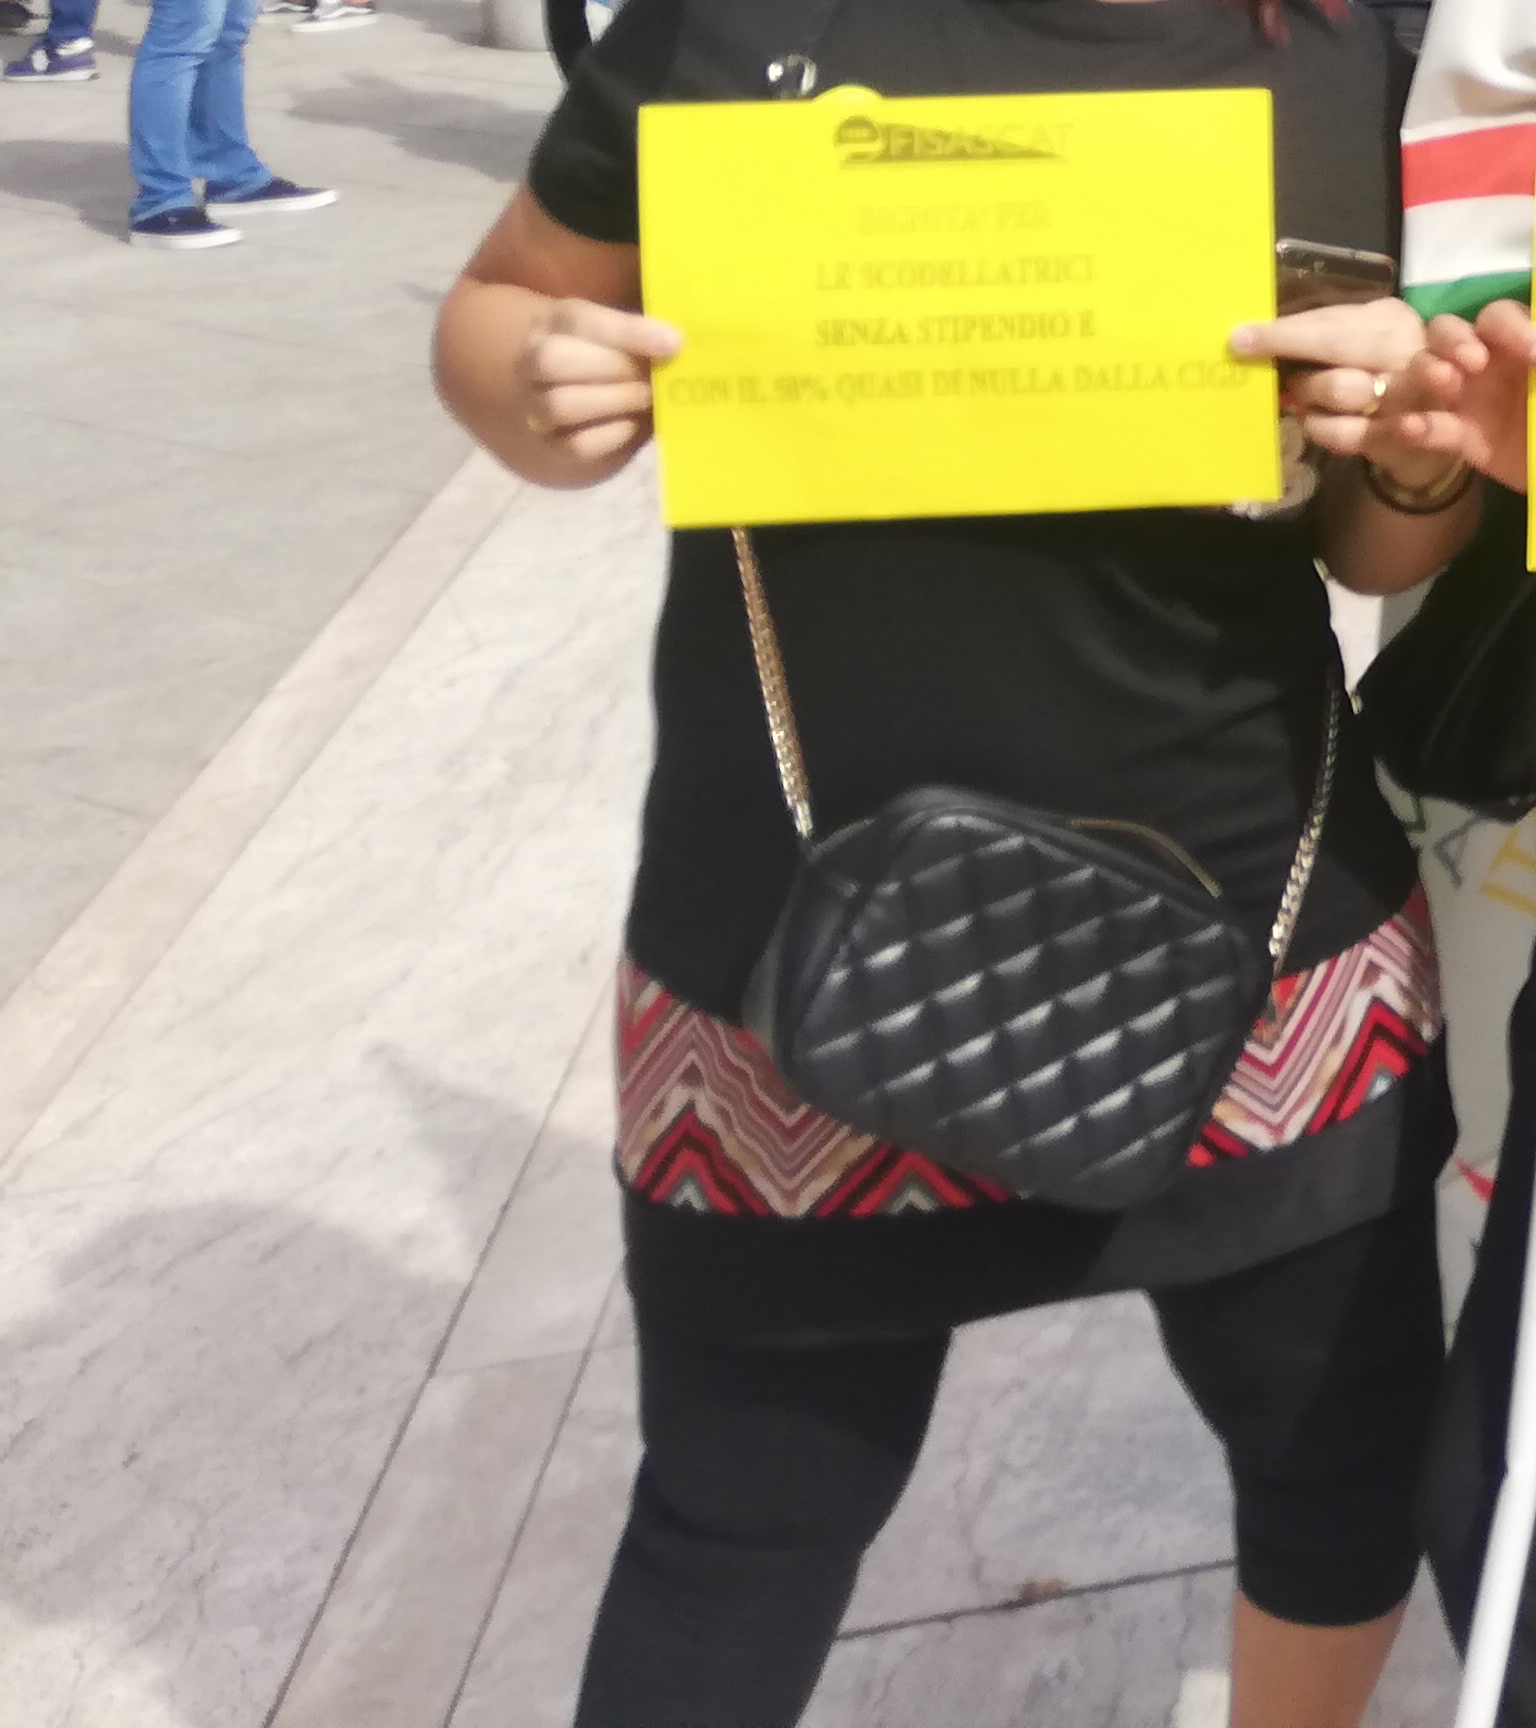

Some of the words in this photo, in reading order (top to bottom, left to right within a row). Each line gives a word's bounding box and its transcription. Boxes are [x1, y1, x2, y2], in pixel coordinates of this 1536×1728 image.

[814, 317, 909, 350] SENZA
[917, 312, 1072, 345] STIPENDIO
[1079, 309, 1098, 339] E
